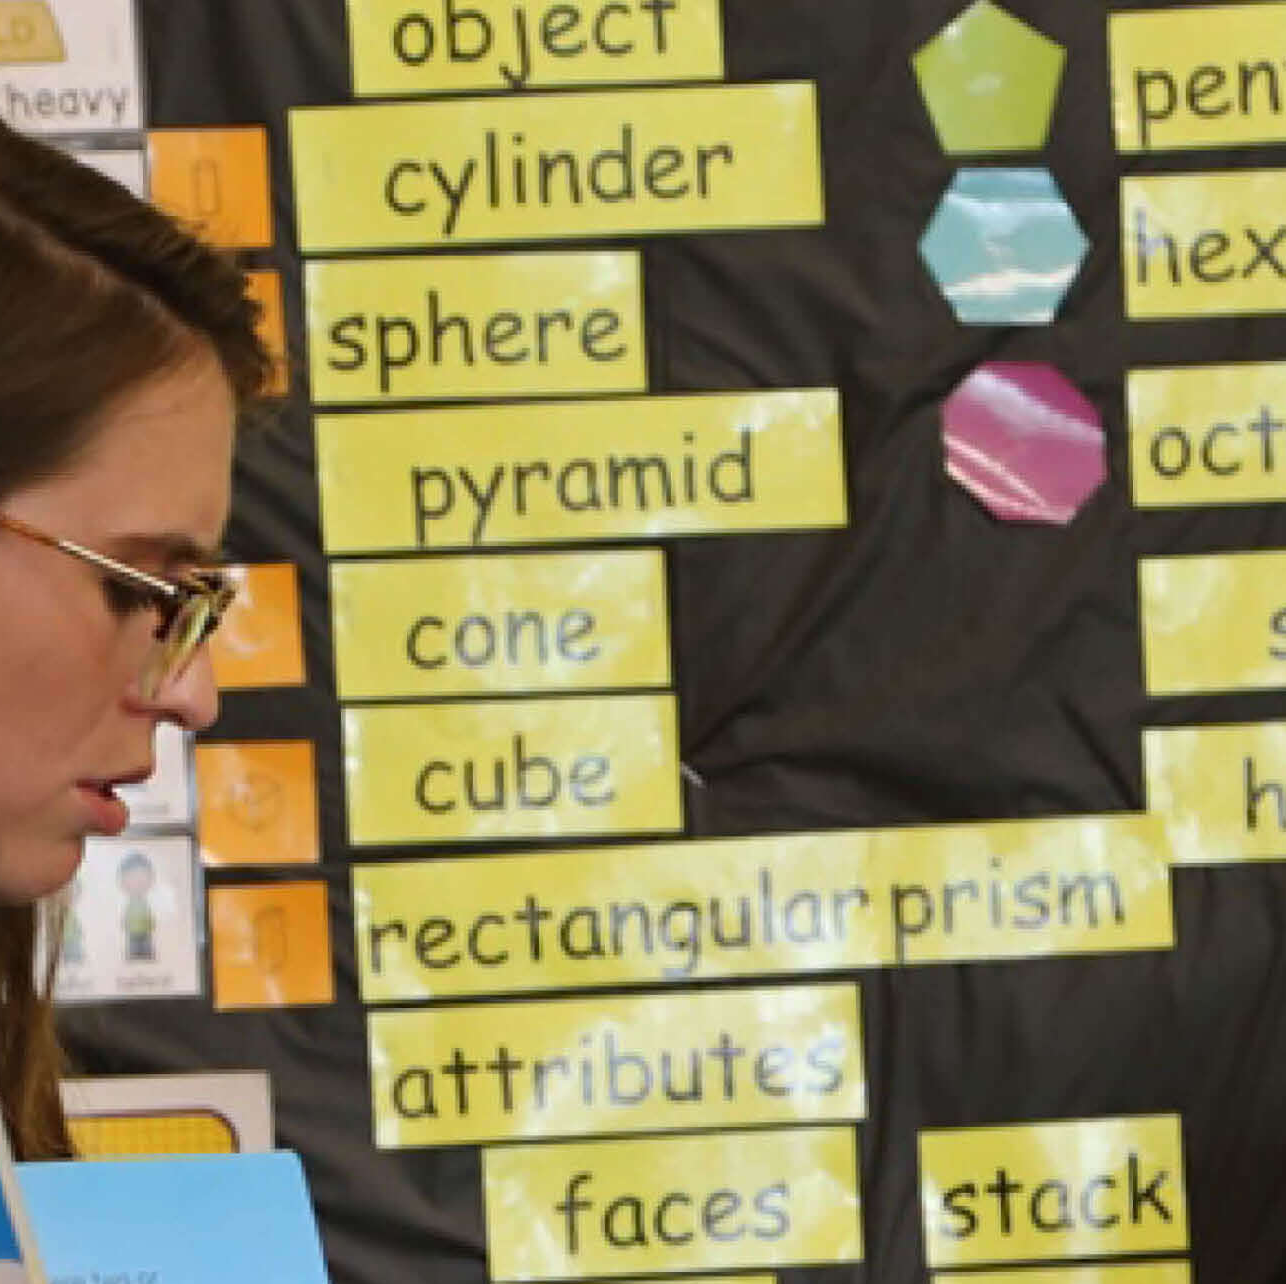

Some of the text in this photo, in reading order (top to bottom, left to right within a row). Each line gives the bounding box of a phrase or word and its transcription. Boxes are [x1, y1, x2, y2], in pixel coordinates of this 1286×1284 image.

[393, 0, 677, 88] object
[5, 83, 128, 125] heavy
[385, 123, 734, 238] cylinder
[327, 289, 628, 393] sphere
[411, 425, 755, 547] pyramid
[406, 607, 601, 670] cone
[415, 734, 617, 815] cube
[368, 856, 1127, 980] rectangular prism
[393, 1030, 847, 1120] attributes
[555, 1172, 792, 1254] faces
[939, 1152, 1174, 1240] stack
